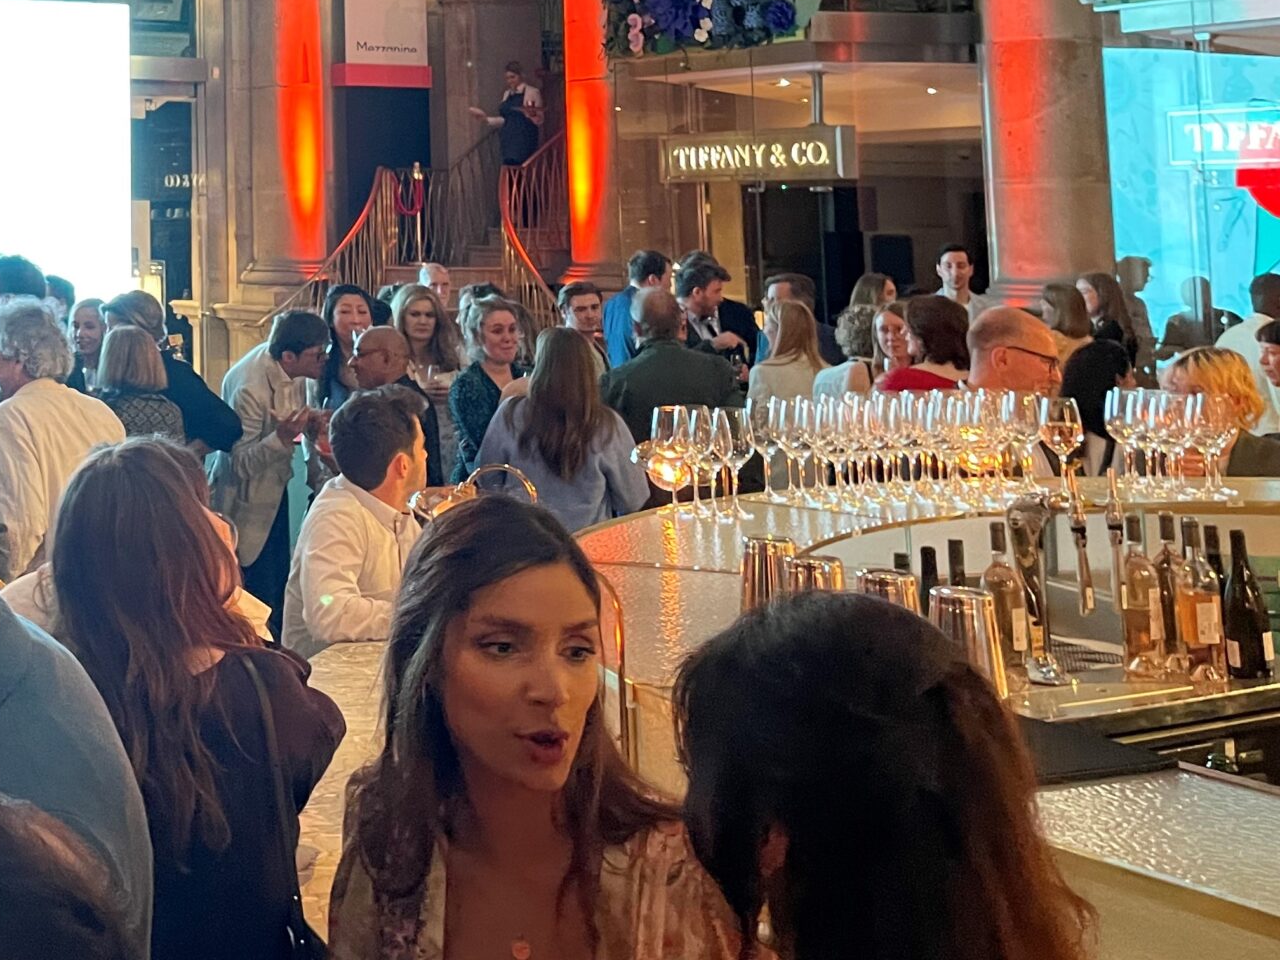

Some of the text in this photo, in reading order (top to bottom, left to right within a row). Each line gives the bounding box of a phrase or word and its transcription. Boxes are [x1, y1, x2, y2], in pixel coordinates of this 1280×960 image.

[673, 141, 830, 170] TIFFANY & CO.
